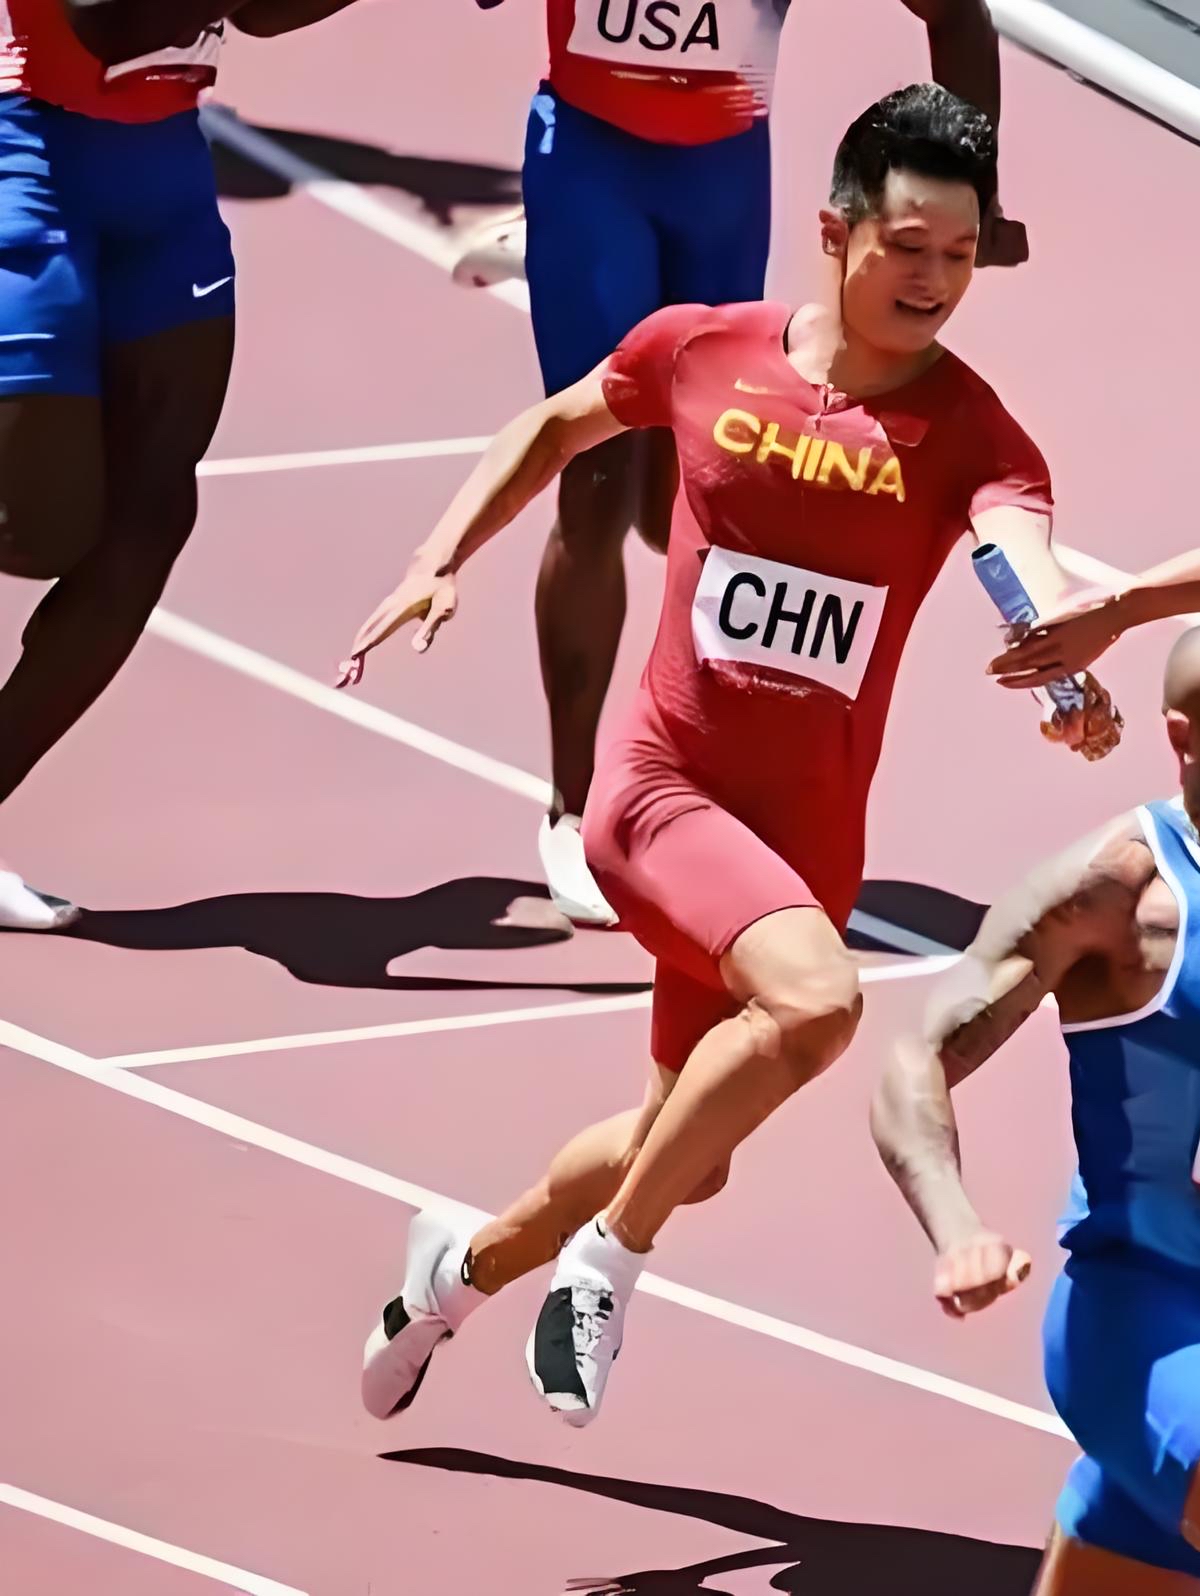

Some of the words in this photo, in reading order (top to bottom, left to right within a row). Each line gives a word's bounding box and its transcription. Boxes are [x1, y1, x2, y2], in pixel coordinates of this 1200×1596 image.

[596, 0, 719, 53] USA
[713, 408, 906, 503] CHINA
[719, 572, 865, 665] CHN
